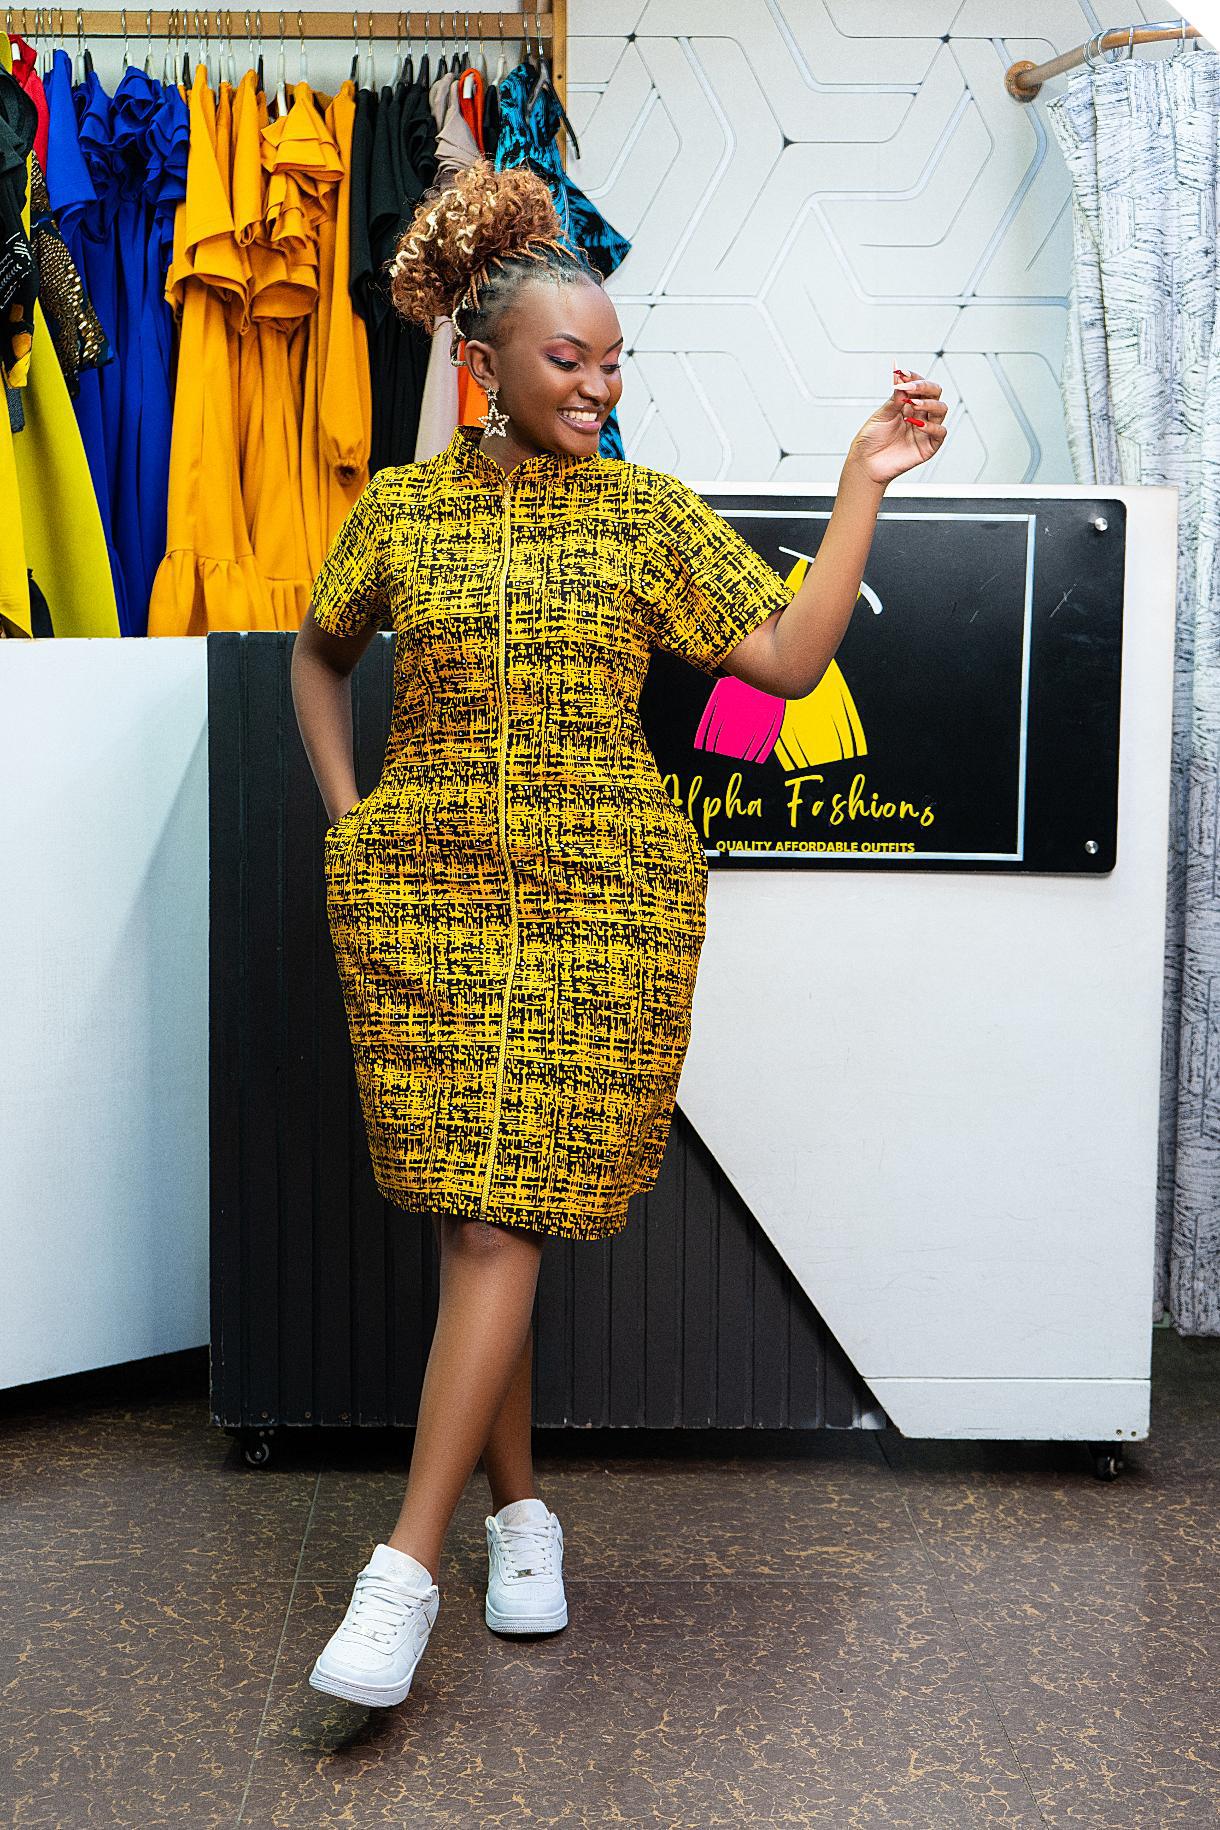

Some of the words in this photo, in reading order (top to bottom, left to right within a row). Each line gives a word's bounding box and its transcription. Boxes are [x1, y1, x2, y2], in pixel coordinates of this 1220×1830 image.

[715, 840, 772, 852] QUALITY
[775, 841, 859, 853] AFFORDABLE
[861, 842, 915, 854] OUTFITS
